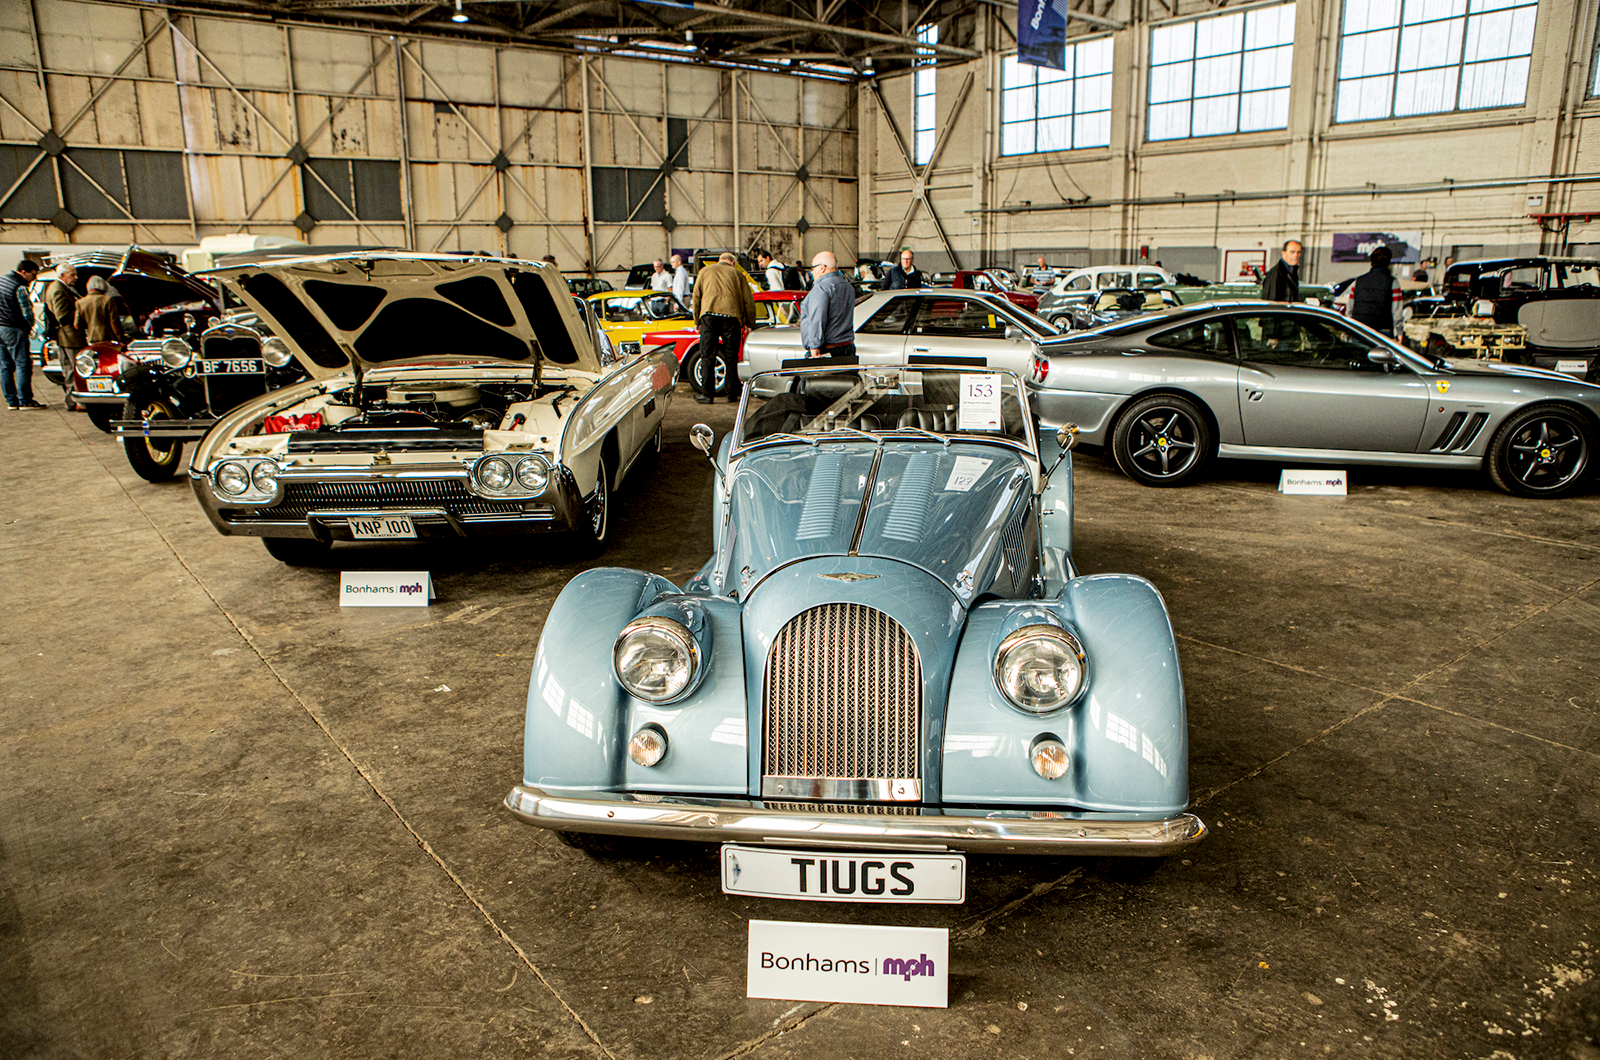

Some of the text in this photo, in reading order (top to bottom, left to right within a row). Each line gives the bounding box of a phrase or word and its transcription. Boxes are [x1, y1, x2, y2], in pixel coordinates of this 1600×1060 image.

[202, 360, 258, 373] BF 7656
[967, 384, 993, 398] 153
[1287, 478, 1343, 487] Bonhams mph
[351, 520, 411, 535] XNP 100
[345, 582, 422, 596] Bonhams mph
[761, 951, 935, 982] Bonhams mph
